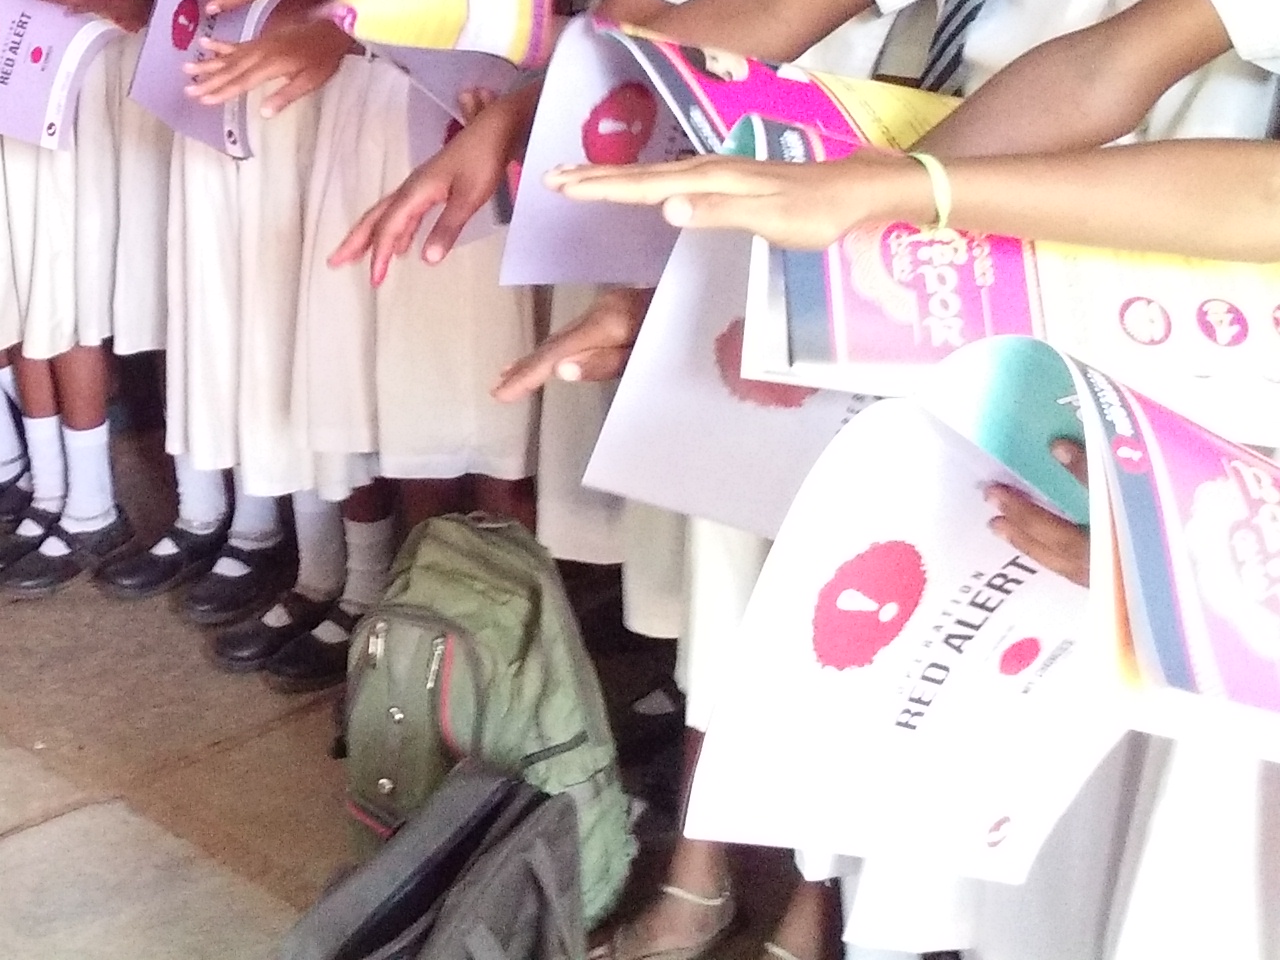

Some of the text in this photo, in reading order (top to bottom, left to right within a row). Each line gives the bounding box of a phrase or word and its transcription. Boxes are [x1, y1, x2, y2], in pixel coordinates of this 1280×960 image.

[8, 11, 32, 56] ALERT
[895, 554, 1039, 730] RED ALERT
